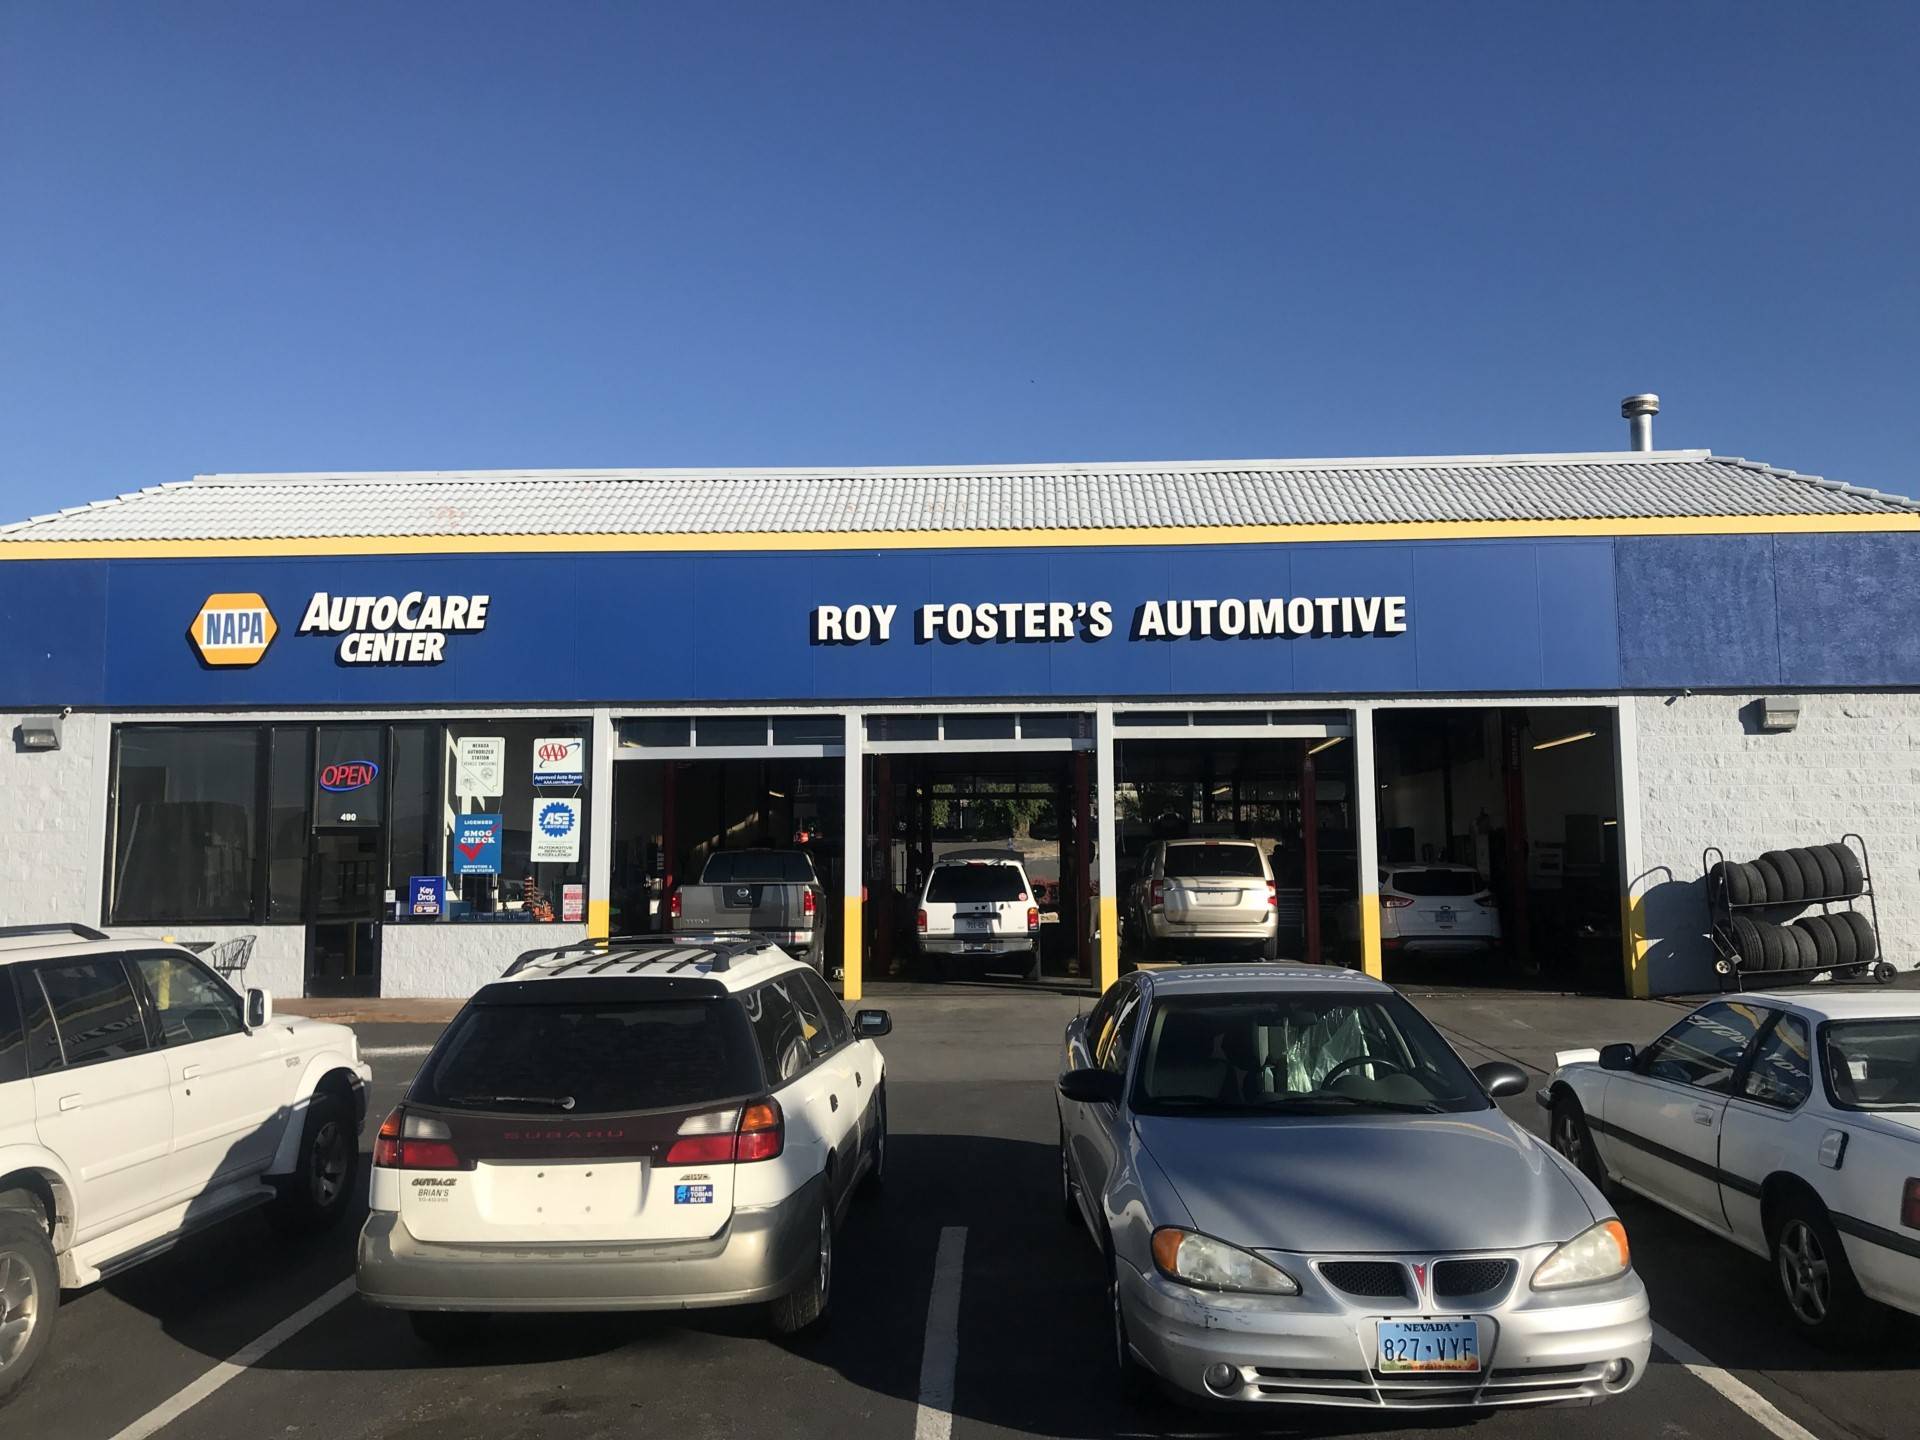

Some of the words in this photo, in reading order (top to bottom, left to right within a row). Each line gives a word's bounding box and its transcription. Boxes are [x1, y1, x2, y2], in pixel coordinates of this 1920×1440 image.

[818, 604, 897, 640] ROY
[923, 601, 1113, 639] FOSTER'S
[1139, 596, 1407, 636] AUTOMOTIVE
[206, 611, 264, 645] NAPA
[340, 632, 445, 663] CENTER
[540, 744, 566, 761] AAA
[322, 765, 373, 785] OPEN
[543, 812, 569, 825] ASE
[419, 887, 434, 895] Key
[417, 894, 436, 902] Drop
[503, 1129, 624, 1140] SUBARU
[411, 1178, 457, 1186] OUTBACK
[418, 1189, 449, 1197] BRIAN'S
[1403, 1323, 1452, 1332] NEVADA
[1384, 1338, 1420, 1362] 827
[1436, 1338, 1473, 1361] VYF
